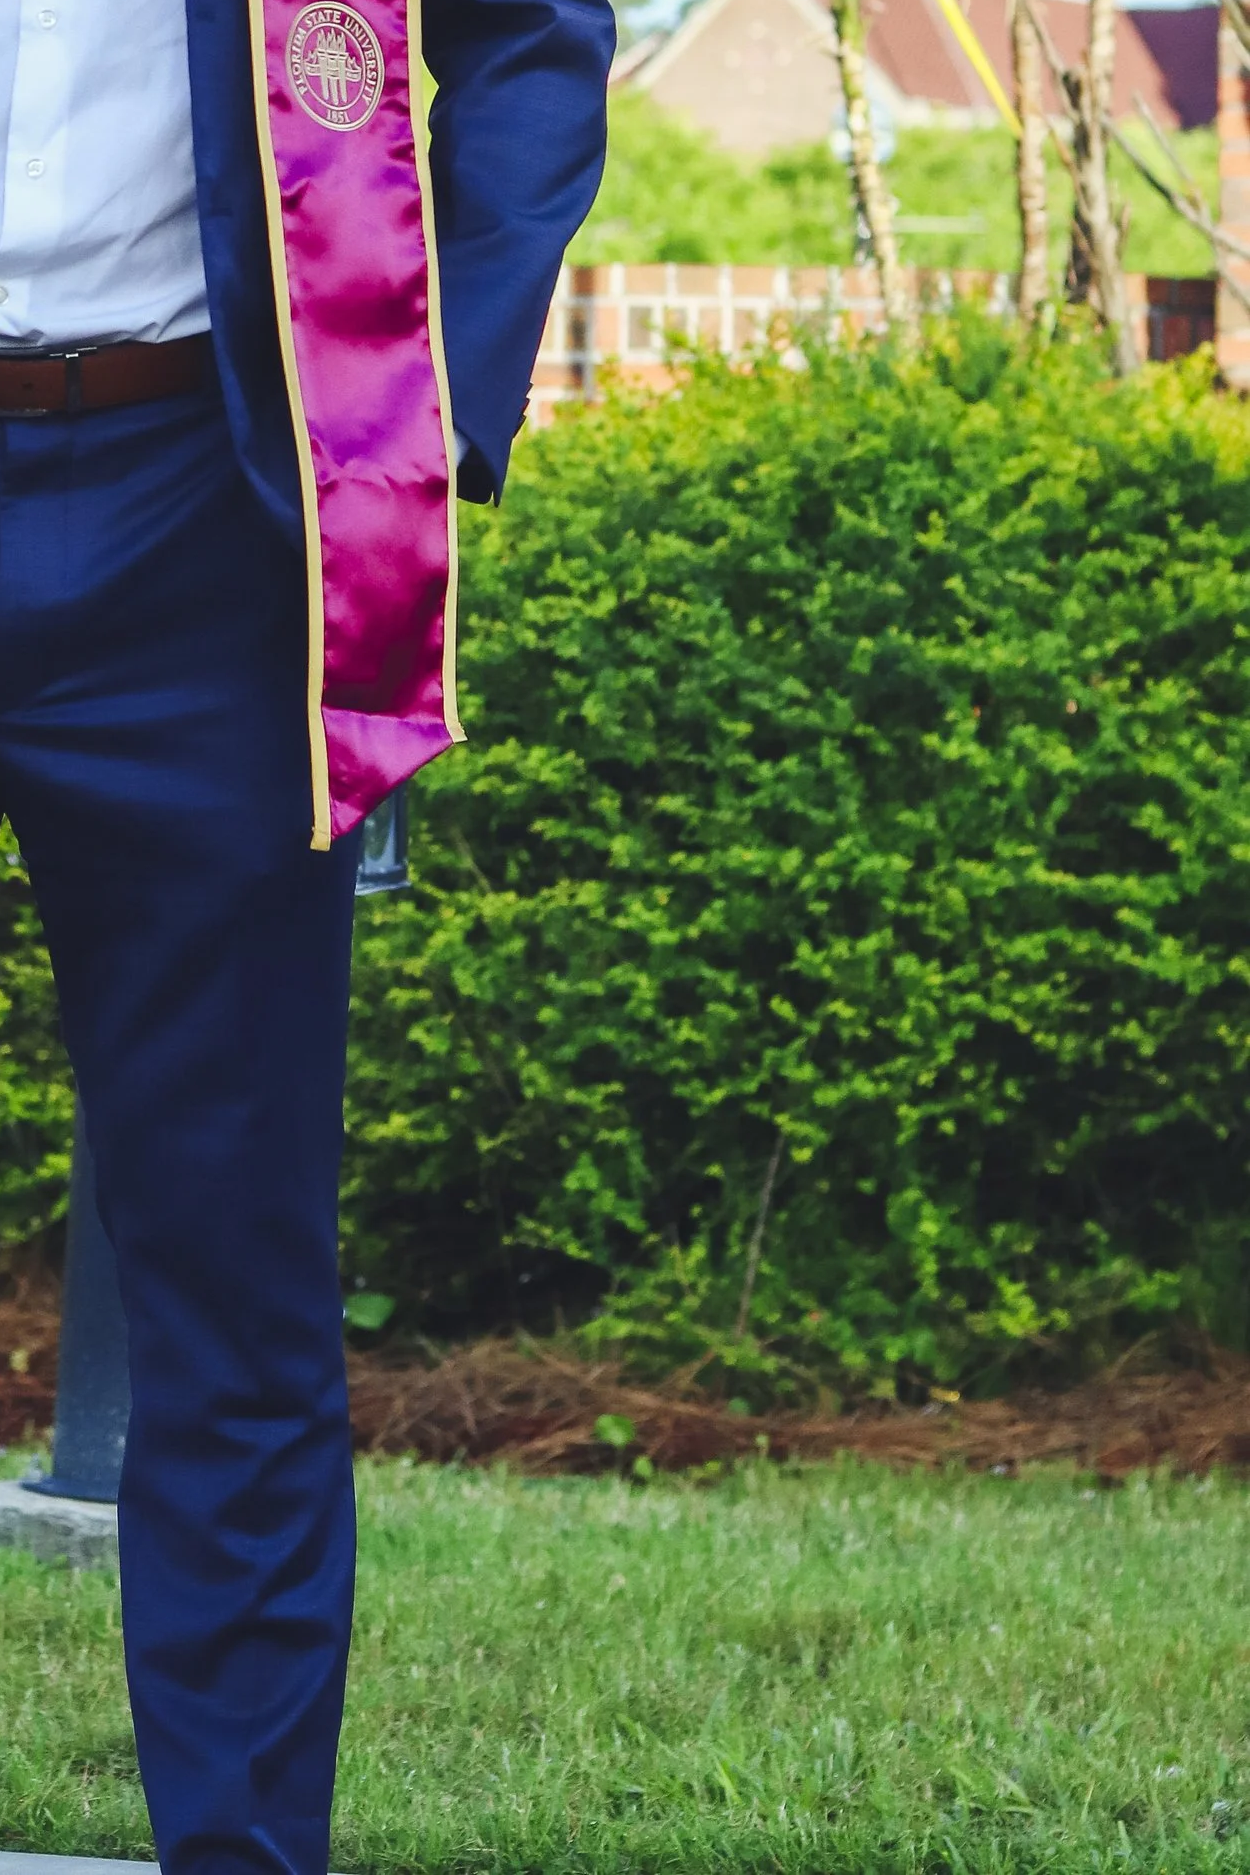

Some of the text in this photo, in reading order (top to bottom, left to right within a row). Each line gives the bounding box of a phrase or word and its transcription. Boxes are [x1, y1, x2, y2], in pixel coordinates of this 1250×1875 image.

[291, 10, 378, 105] FLORIDA STATE UNIVERSITY
[326, 109, 352, 124] 1851
